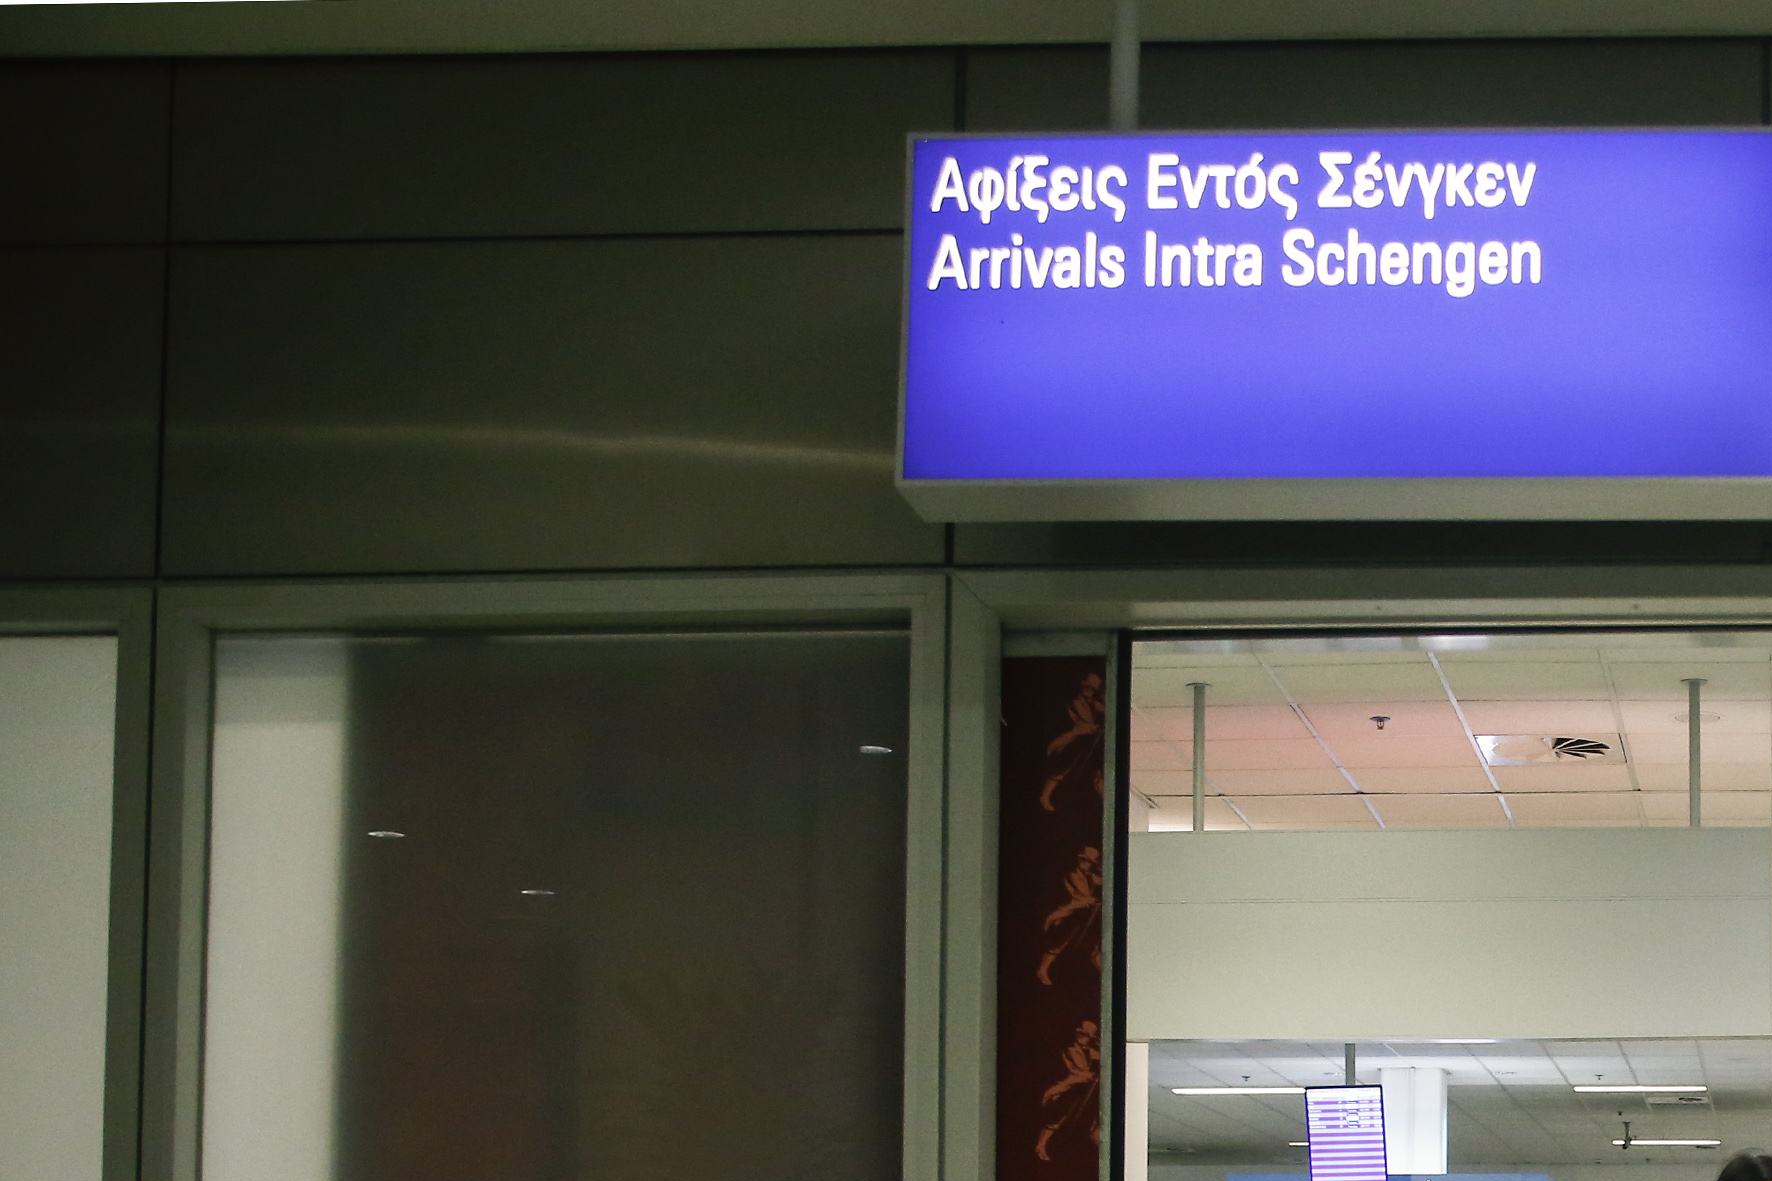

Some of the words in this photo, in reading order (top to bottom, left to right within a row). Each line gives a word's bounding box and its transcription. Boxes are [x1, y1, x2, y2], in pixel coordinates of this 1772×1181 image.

[930, 153, 1127, 224] Αφίξεις
[1147, 152, 1300, 220] Εντός
[1317, 151, 1537, 219] Σένγκεν
[926, 231, 1125, 291] Arrivals
[1144, 231, 1263, 287] Intra
[1281, 227, 1542, 298] Schengen
